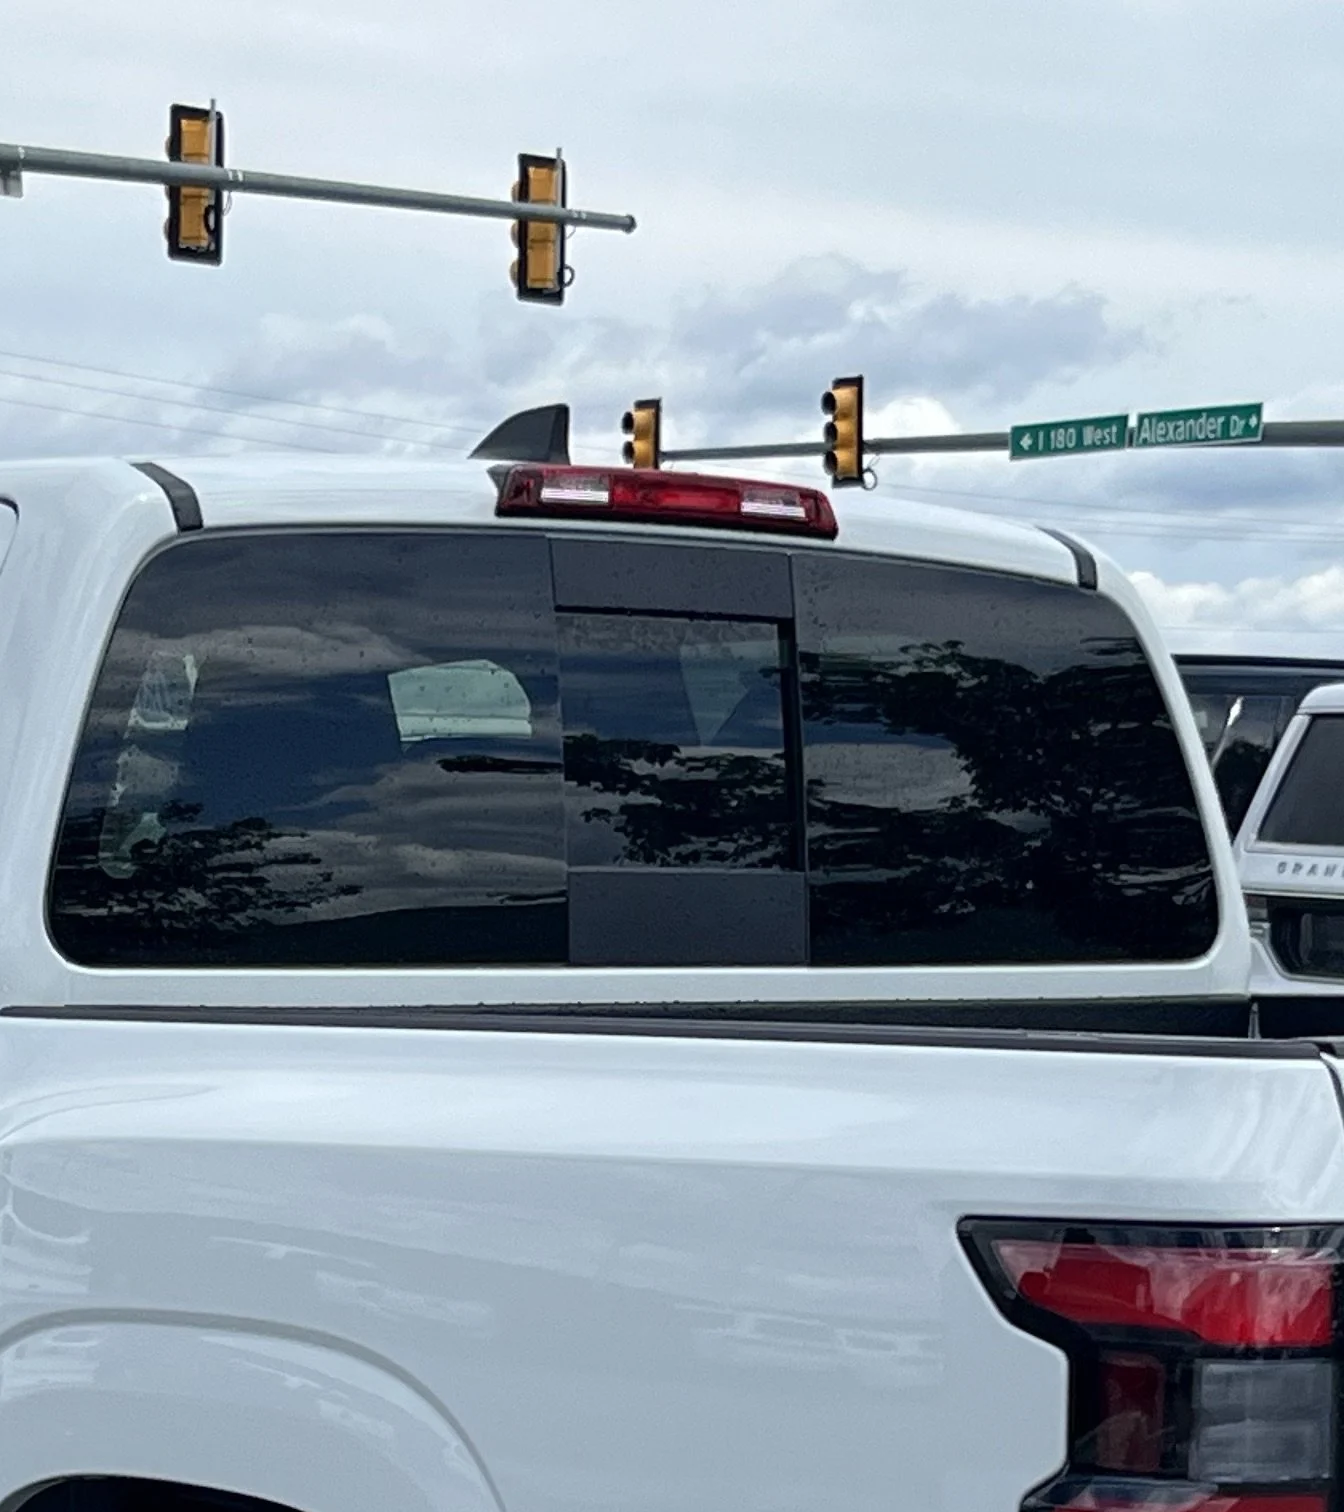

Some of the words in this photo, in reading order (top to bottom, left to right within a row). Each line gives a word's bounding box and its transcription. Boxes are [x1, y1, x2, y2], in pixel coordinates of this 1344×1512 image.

[1050, 428, 1075, 449] 180
[1083, 425, 1117, 446] West
[1139, 413, 1224, 443] Alexander
[1230, 416, 1246, 437] Dr
